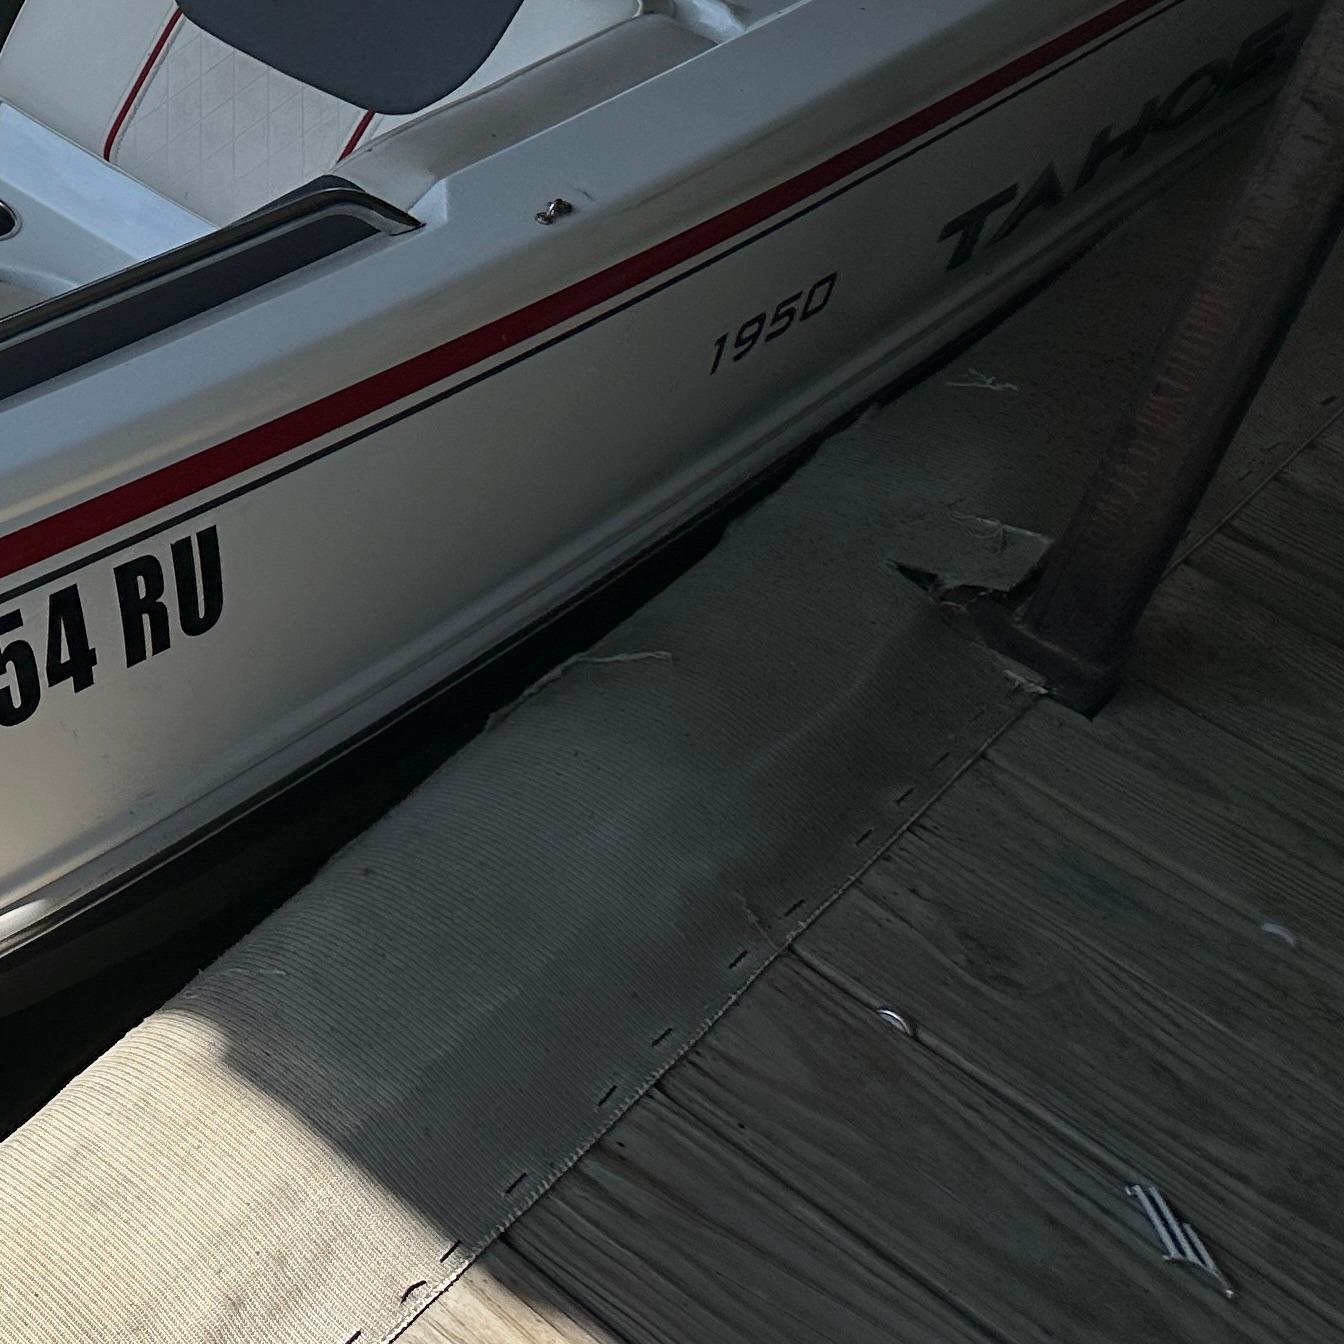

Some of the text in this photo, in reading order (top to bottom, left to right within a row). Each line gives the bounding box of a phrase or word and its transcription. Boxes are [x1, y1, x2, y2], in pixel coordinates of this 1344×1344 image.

[937, 4, 1304, 272] TAHOE
[710, 271, 838, 376] 1950
[112, 525, 224, 669] RU
